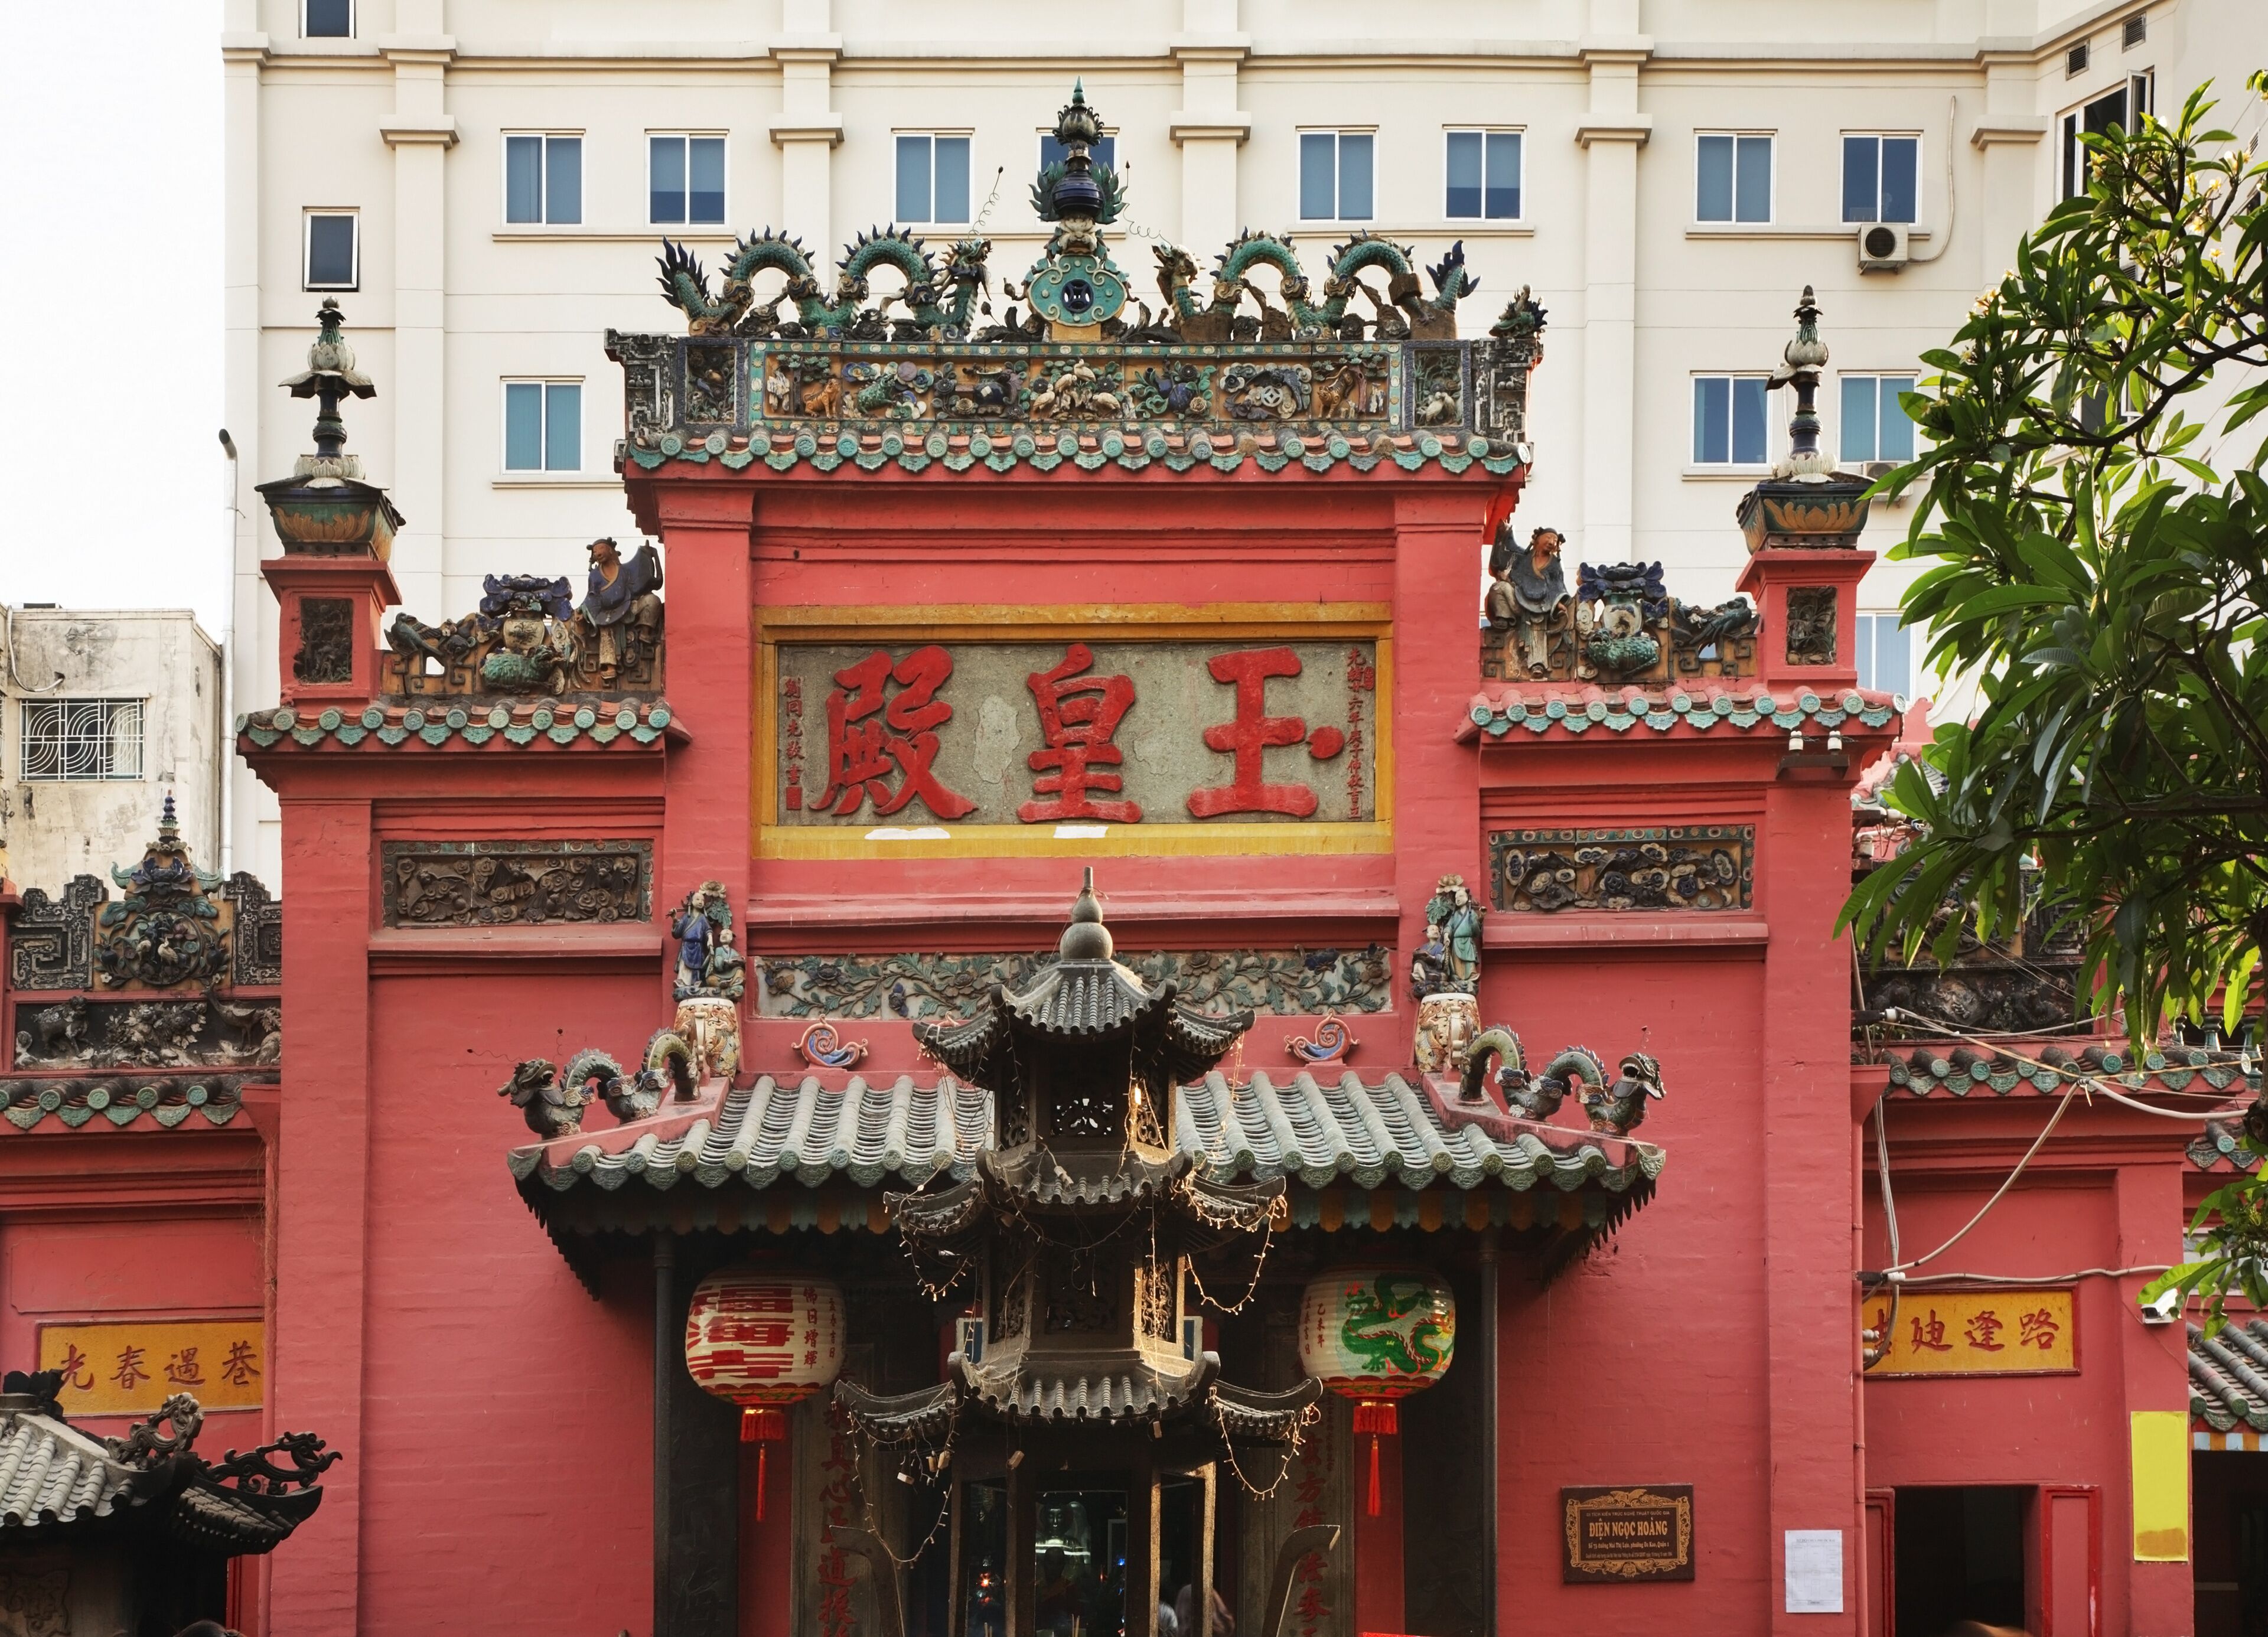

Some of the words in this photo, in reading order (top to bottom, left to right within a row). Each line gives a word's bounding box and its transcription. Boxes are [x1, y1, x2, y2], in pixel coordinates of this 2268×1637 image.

[1589, 1518, 1609, 1540] ĐIỆN
[1612, 1522, 1635, 1539] NGỌC
[1638, 1517, 1668, 1536] HOÀNG
